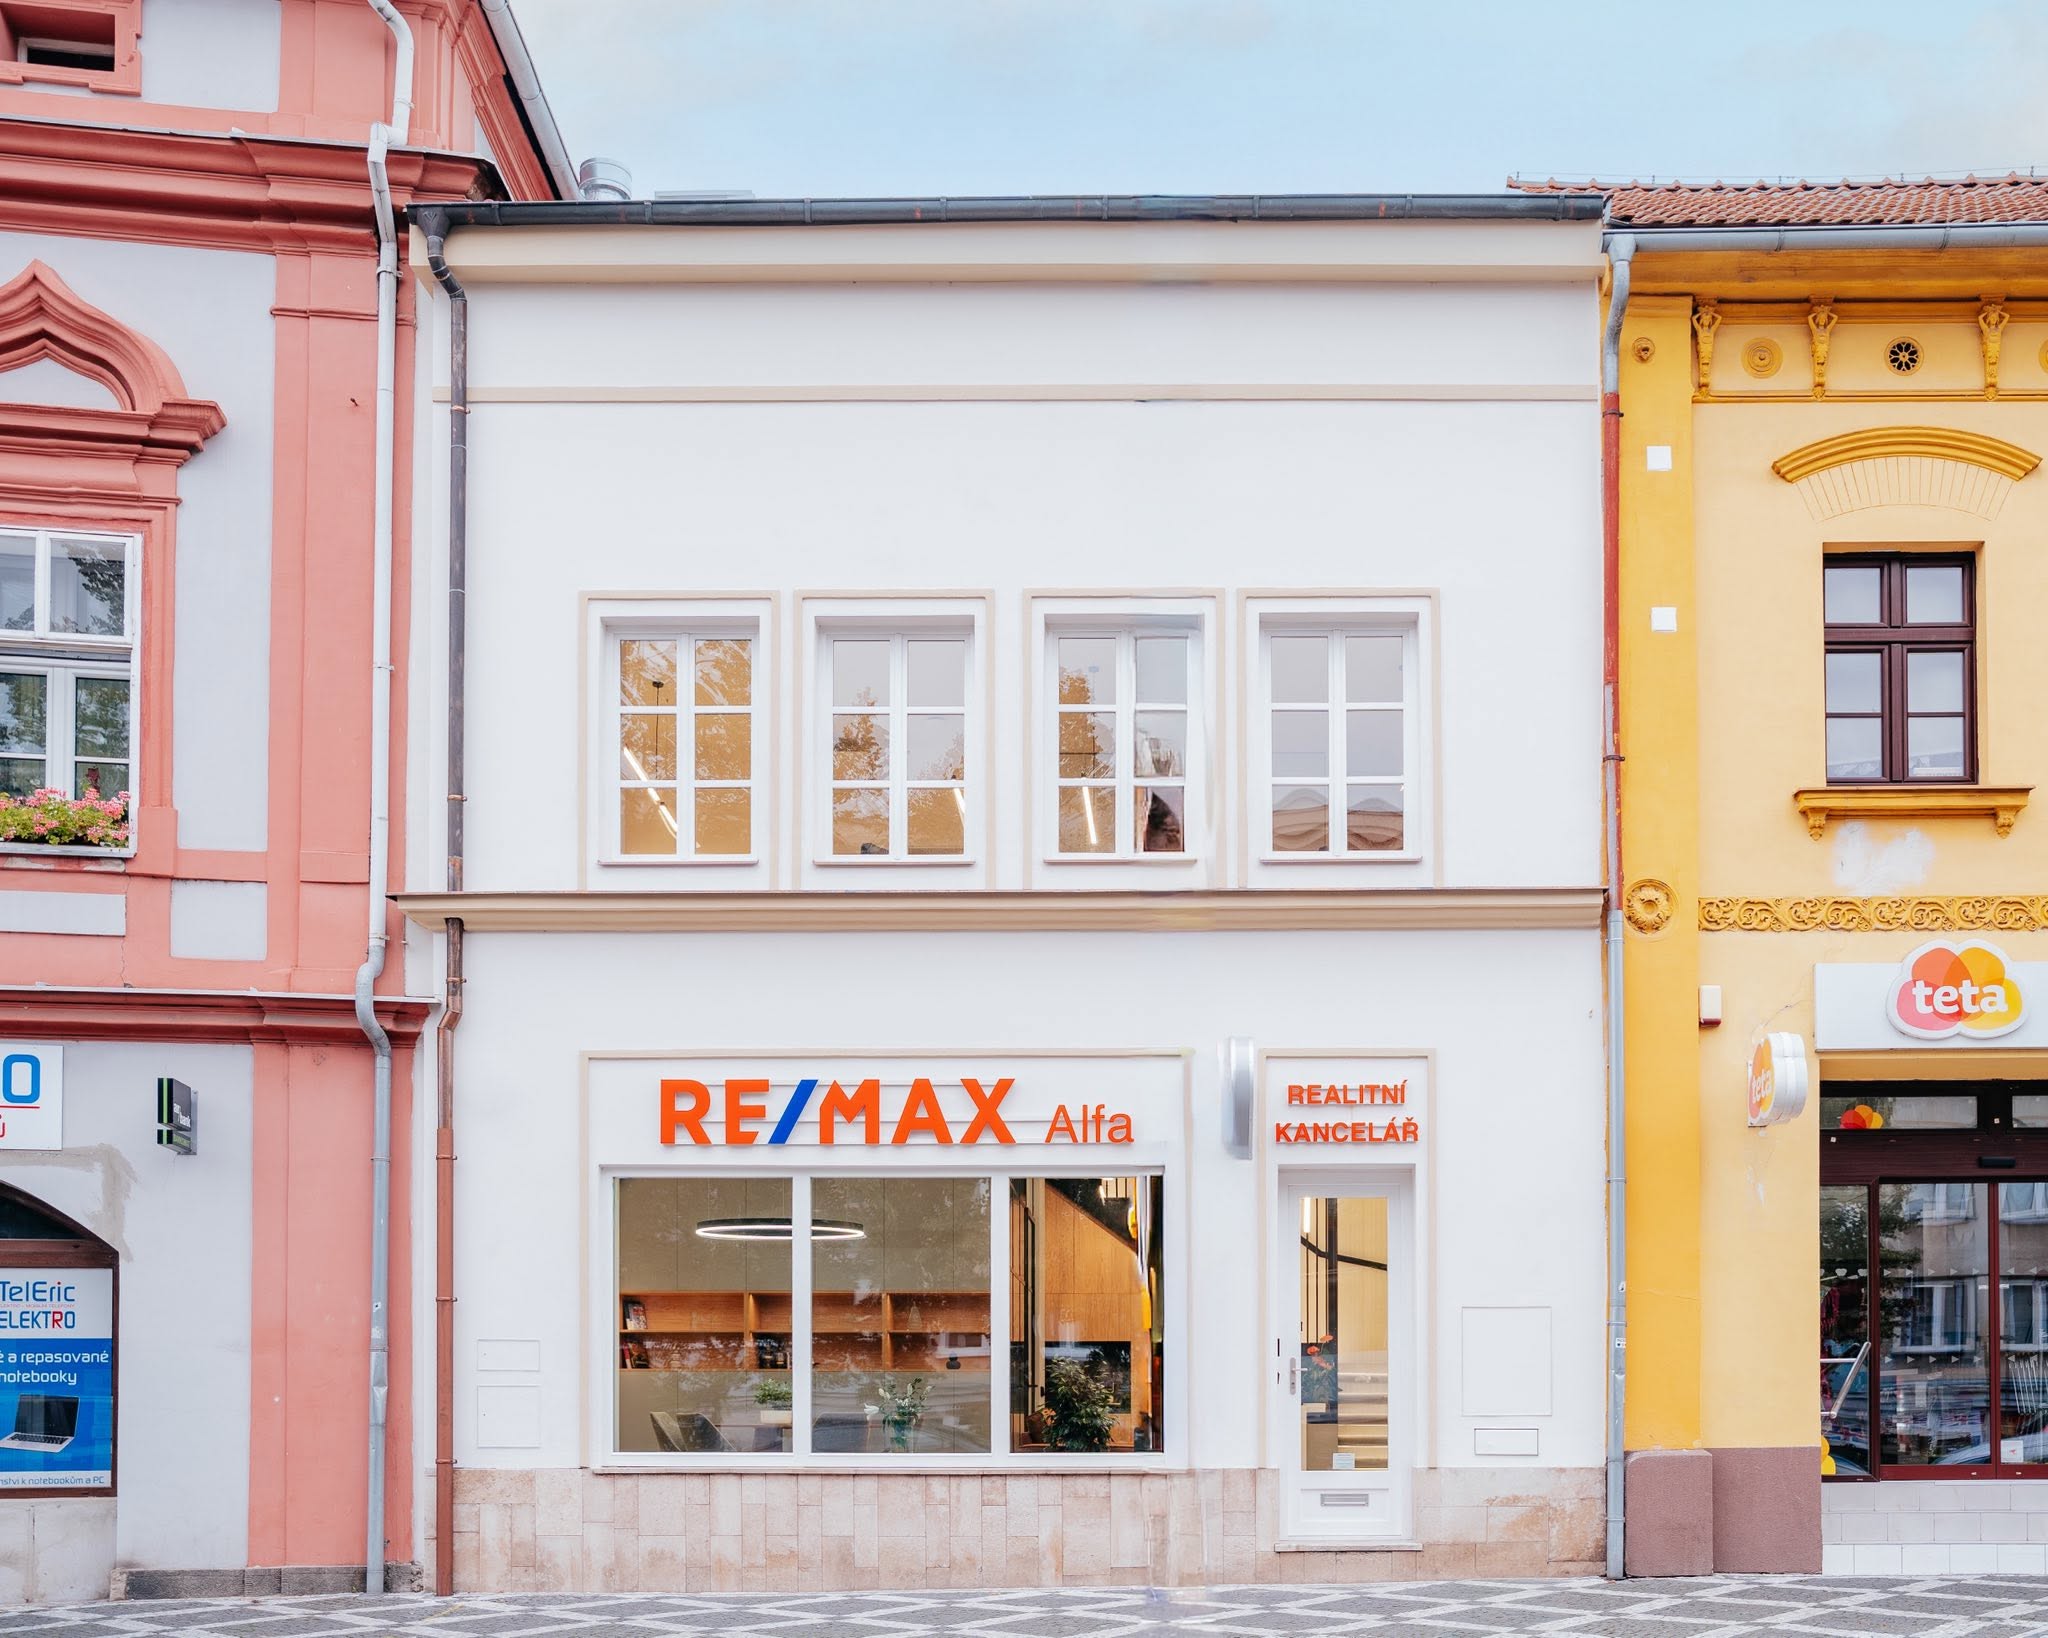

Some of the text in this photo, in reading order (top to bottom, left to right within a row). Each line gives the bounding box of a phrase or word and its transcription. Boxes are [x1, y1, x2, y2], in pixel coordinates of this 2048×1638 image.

[1911, 979, 2009, 1014] teta
[1287, 1079, 1408, 1105] REALITNÍ
[1752, 1067, 1772, 1104] teta
[660, 1078, 1134, 1145] RE/MAX Alfa
[1275, 1116, 1419, 1143] KANCELÁŘ
[0, 1281, 76, 1301] TelEric
[0, 1311, 76, 1329] ELEKTRO
[8, 1353, 17, 1363] a
[21, 1350, 109, 1365] repasované
[0, 1370, 77, 1385] notebooky
[93, 1475, 105, 1484] PC
